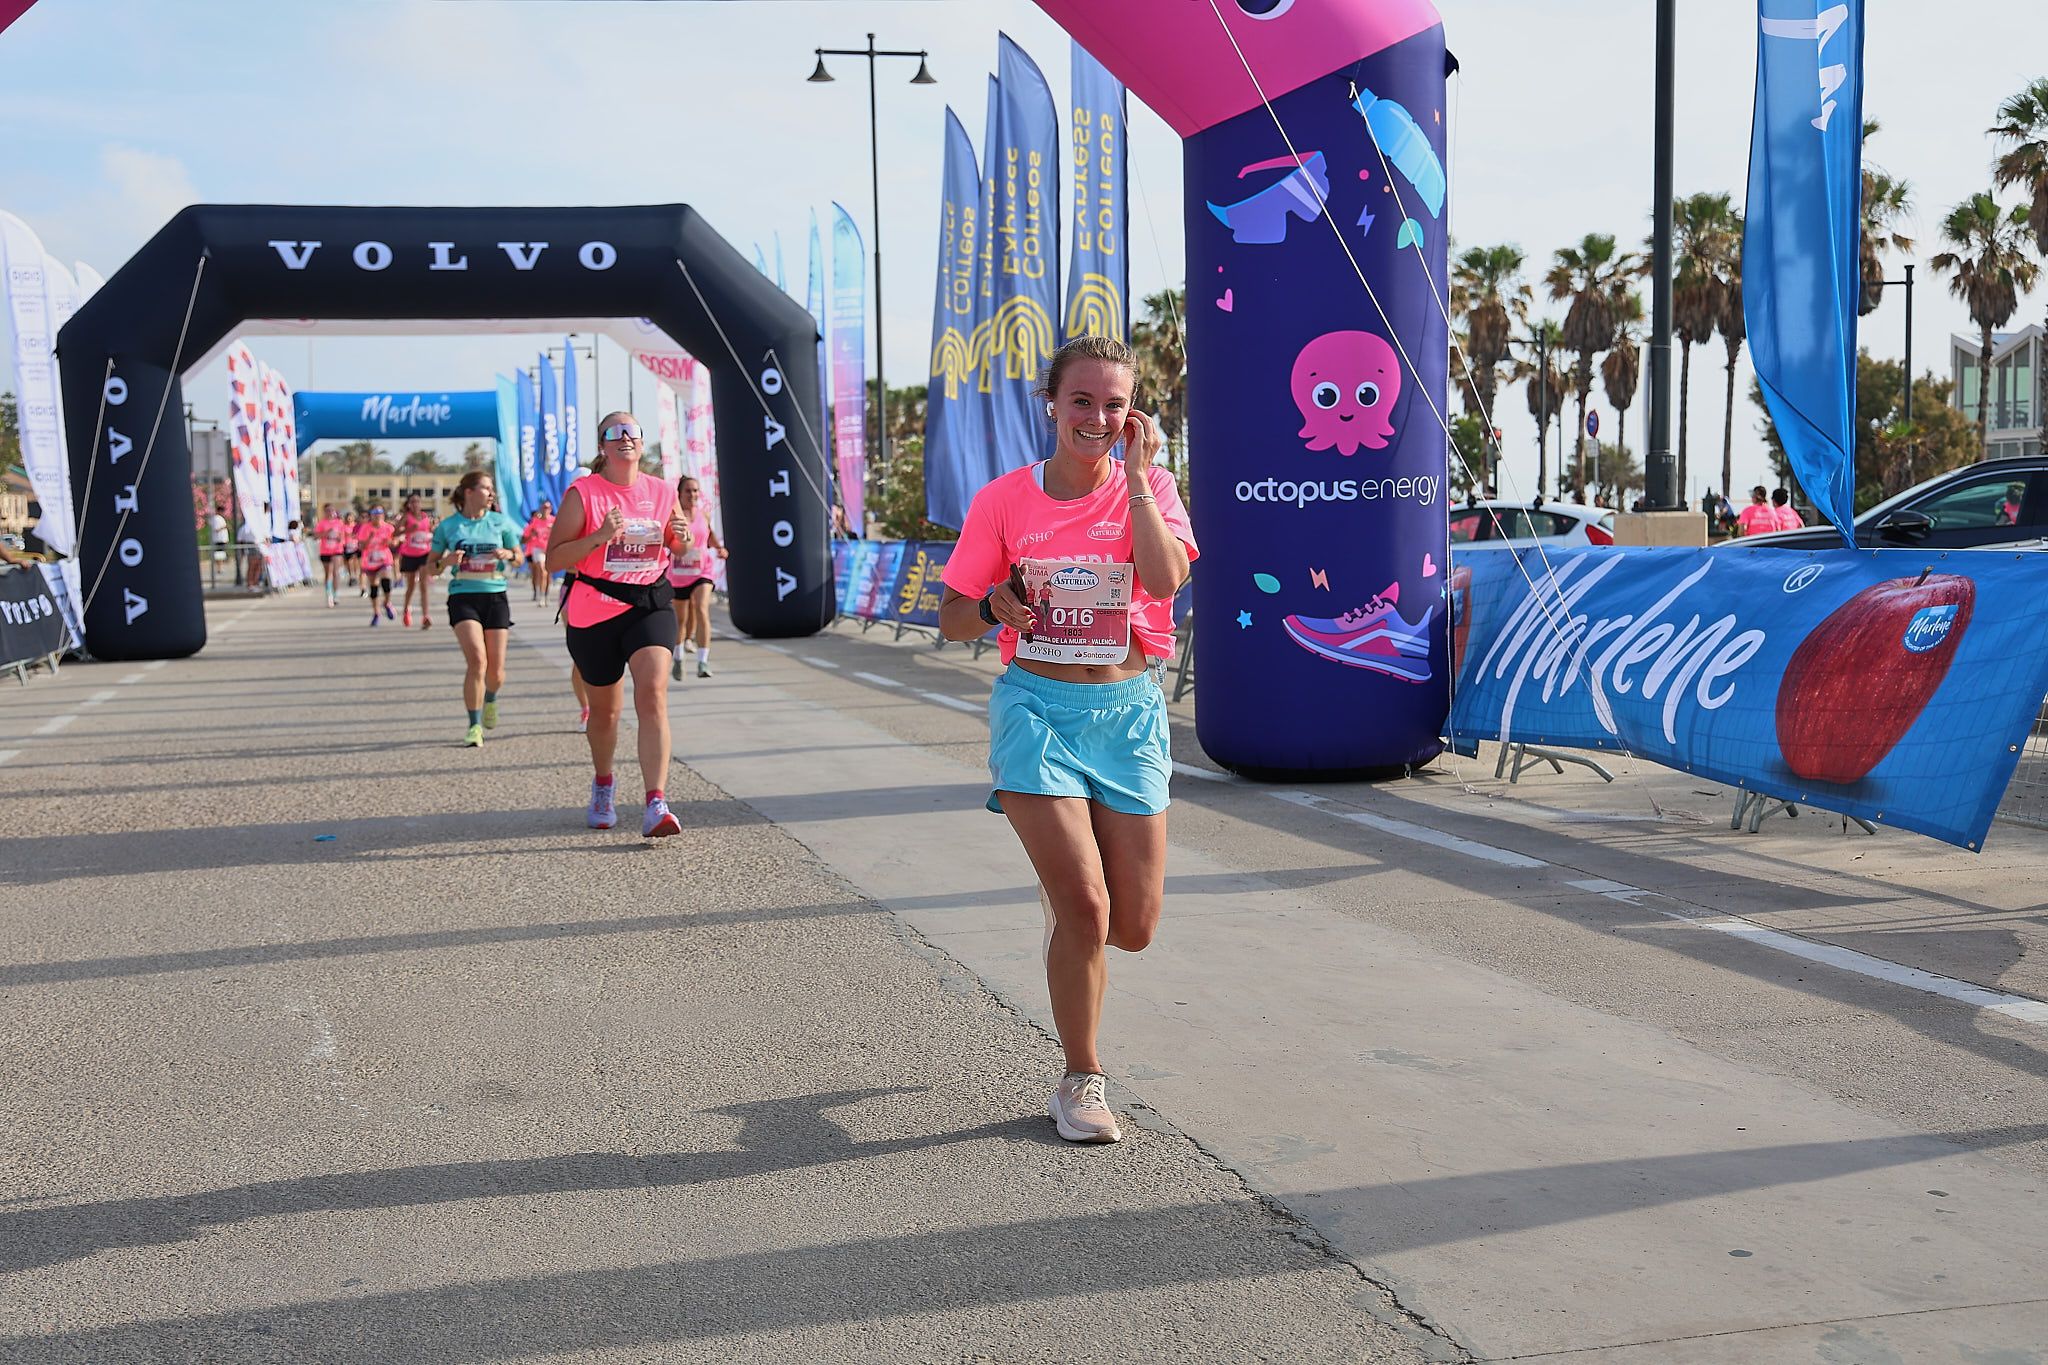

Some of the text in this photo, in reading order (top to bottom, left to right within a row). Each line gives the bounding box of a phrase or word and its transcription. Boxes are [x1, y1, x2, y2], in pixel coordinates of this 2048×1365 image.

[268, 240, 618, 272] VOLVO
[361, 395, 452, 434] Marlene
[760, 367, 799, 602] VOLVO
[1235, 475, 1440, 509] octopus energy
[104, 376, 150, 626] VOLVO
[623, 544, 646, 553] 016
[1016, 530, 1054, 550] OYSHO
[1028, 568, 1049, 577] SUMA
[1053, 575, 1096, 586] ASTURIANA
[1052, 607, 1094, 625] 016
[1031, 633, 1051, 643] ARRERA
[1063, 628, 1083, 637] 1803
[1908, 616, 1951, 642] Marlene
[1029, 645, 1062, 657] OYSHO
[1083, 651, 1117, 659] Santander
[1475, 552, 1766, 744] Marlene
